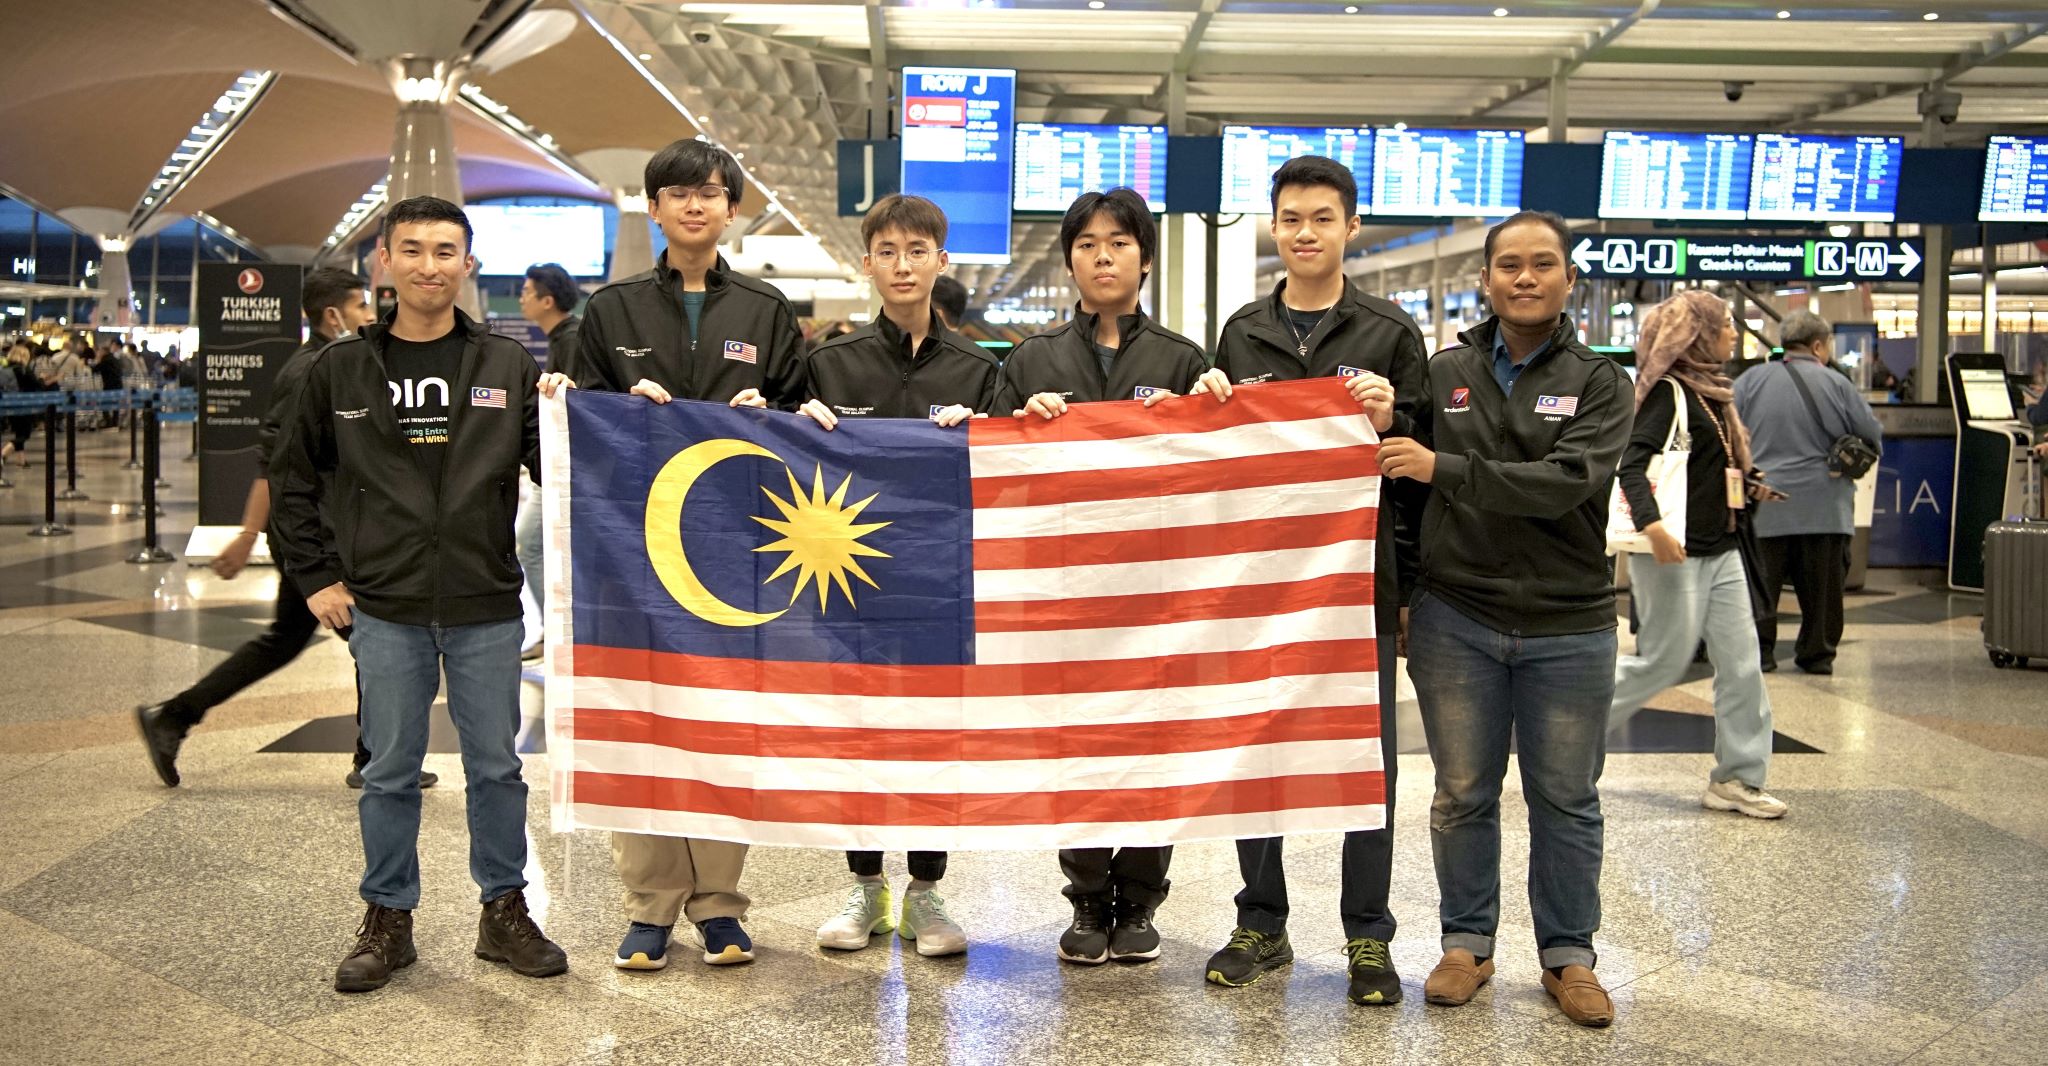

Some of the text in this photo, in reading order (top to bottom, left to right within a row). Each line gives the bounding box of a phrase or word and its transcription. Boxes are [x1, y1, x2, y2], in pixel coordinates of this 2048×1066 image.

[921, 74, 967, 92] ROW
[854, 145, 874, 212] J
[1608, 244, 1667, 269] A J
[1687, 243, 1804, 257] Kaunter Daftar Masuk
[1699, 258, 1791, 272] Check-in Counters
[1822, 246, 1883, 271] K M
[221, 296, 281, 309] TURKISH
[221, 309, 281, 321] AIRLINES
[207, 354, 263, 368] BUSINESS
[207, 367, 243, 381] CLASS
